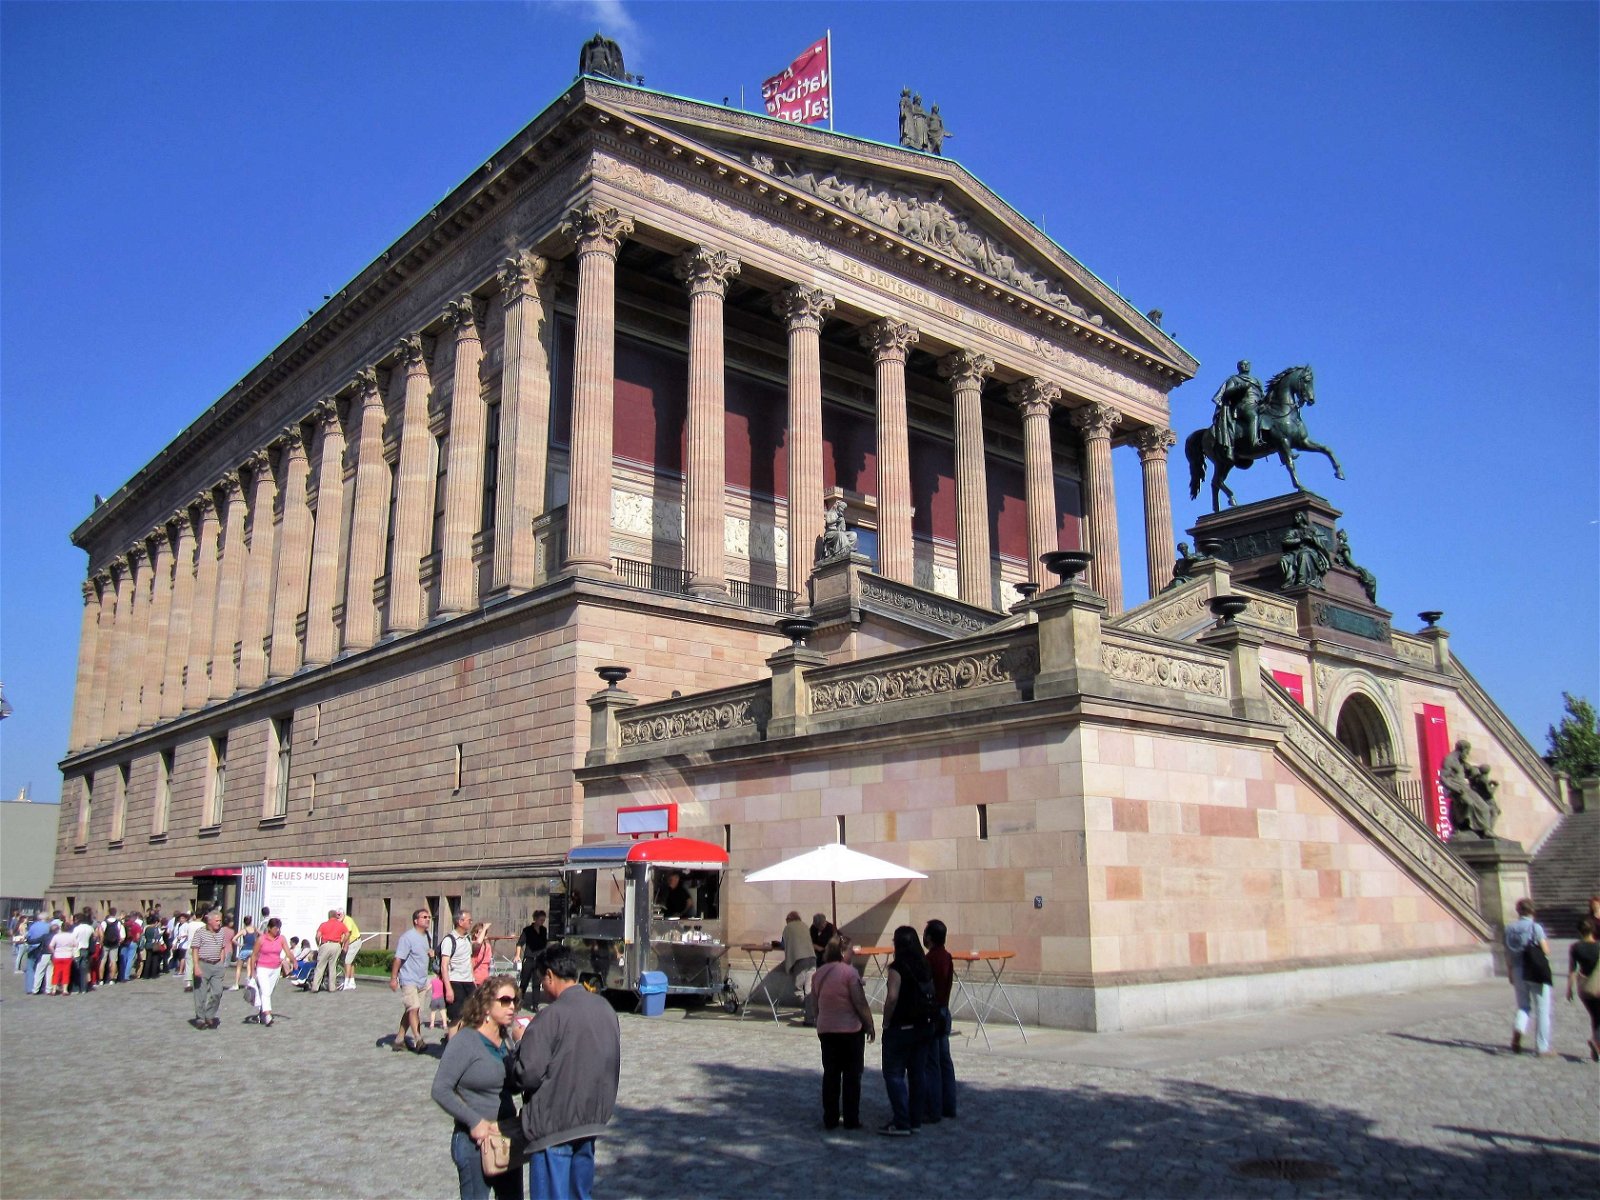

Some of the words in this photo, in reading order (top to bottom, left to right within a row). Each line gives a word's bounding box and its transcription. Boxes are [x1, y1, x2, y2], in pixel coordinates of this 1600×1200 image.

[842, 259, 865, 278] DER
[870, 271, 930, 305] DEUTSCHEN
[935, 298, 967, 320] KUNST
[972, 313, 1023, 345] MDCCCLXXI
[271, 871, 302, 881] NEUES
[304, 872, 345, 881] MUSEUM
